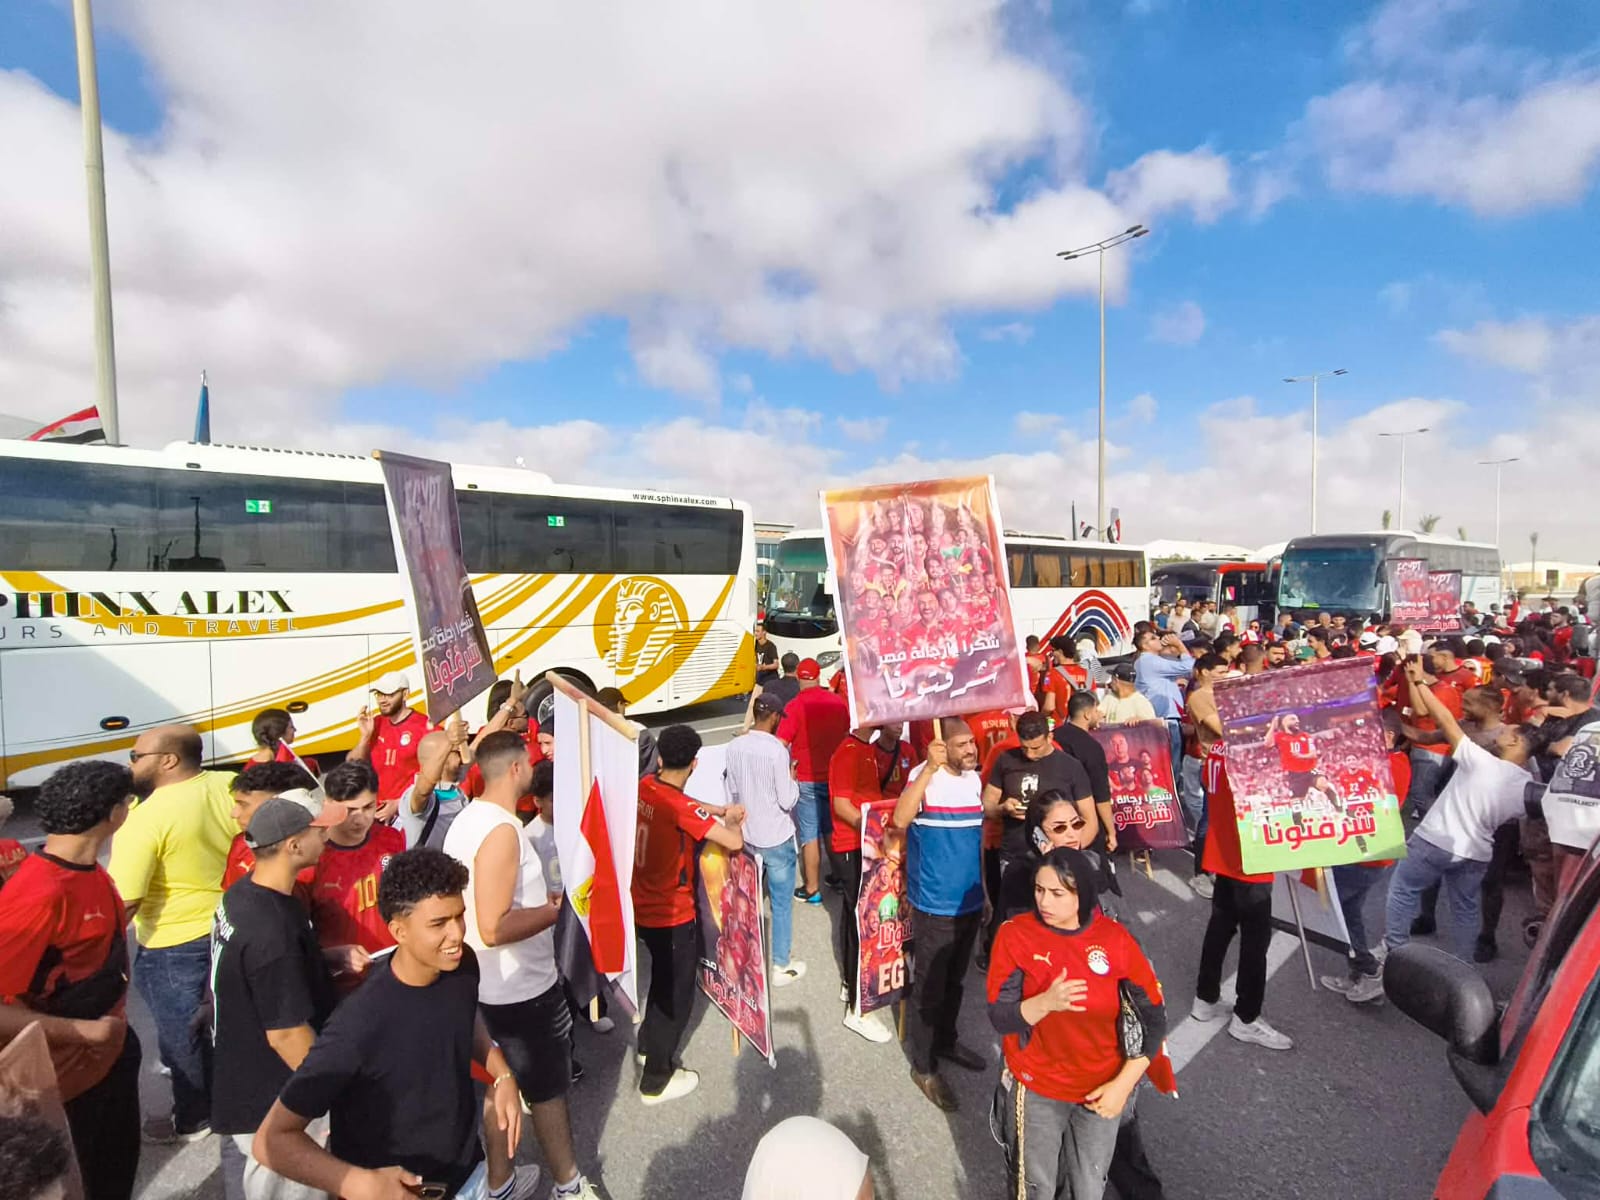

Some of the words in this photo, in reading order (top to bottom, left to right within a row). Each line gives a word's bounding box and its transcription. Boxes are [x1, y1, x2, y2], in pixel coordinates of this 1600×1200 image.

[174, 590, 294, 615] ALEX
[93, 622, 159, 636] AND
[184, 617, 298, 634] TRAVEL
[962, 633, 1000, 657] شكرا
[425, 636, 482, 697] شرفتونا
[877, 650, 906, 669] مصر
[1116, 795, 1142, 806] رجالة
[1143, 792, 1173, 805] شكرا
[1113, 801, 1173, 831] شرفتو
[1262, 806, 1377, 850] شرفتونا
[353, 873, 377, 912] 10
